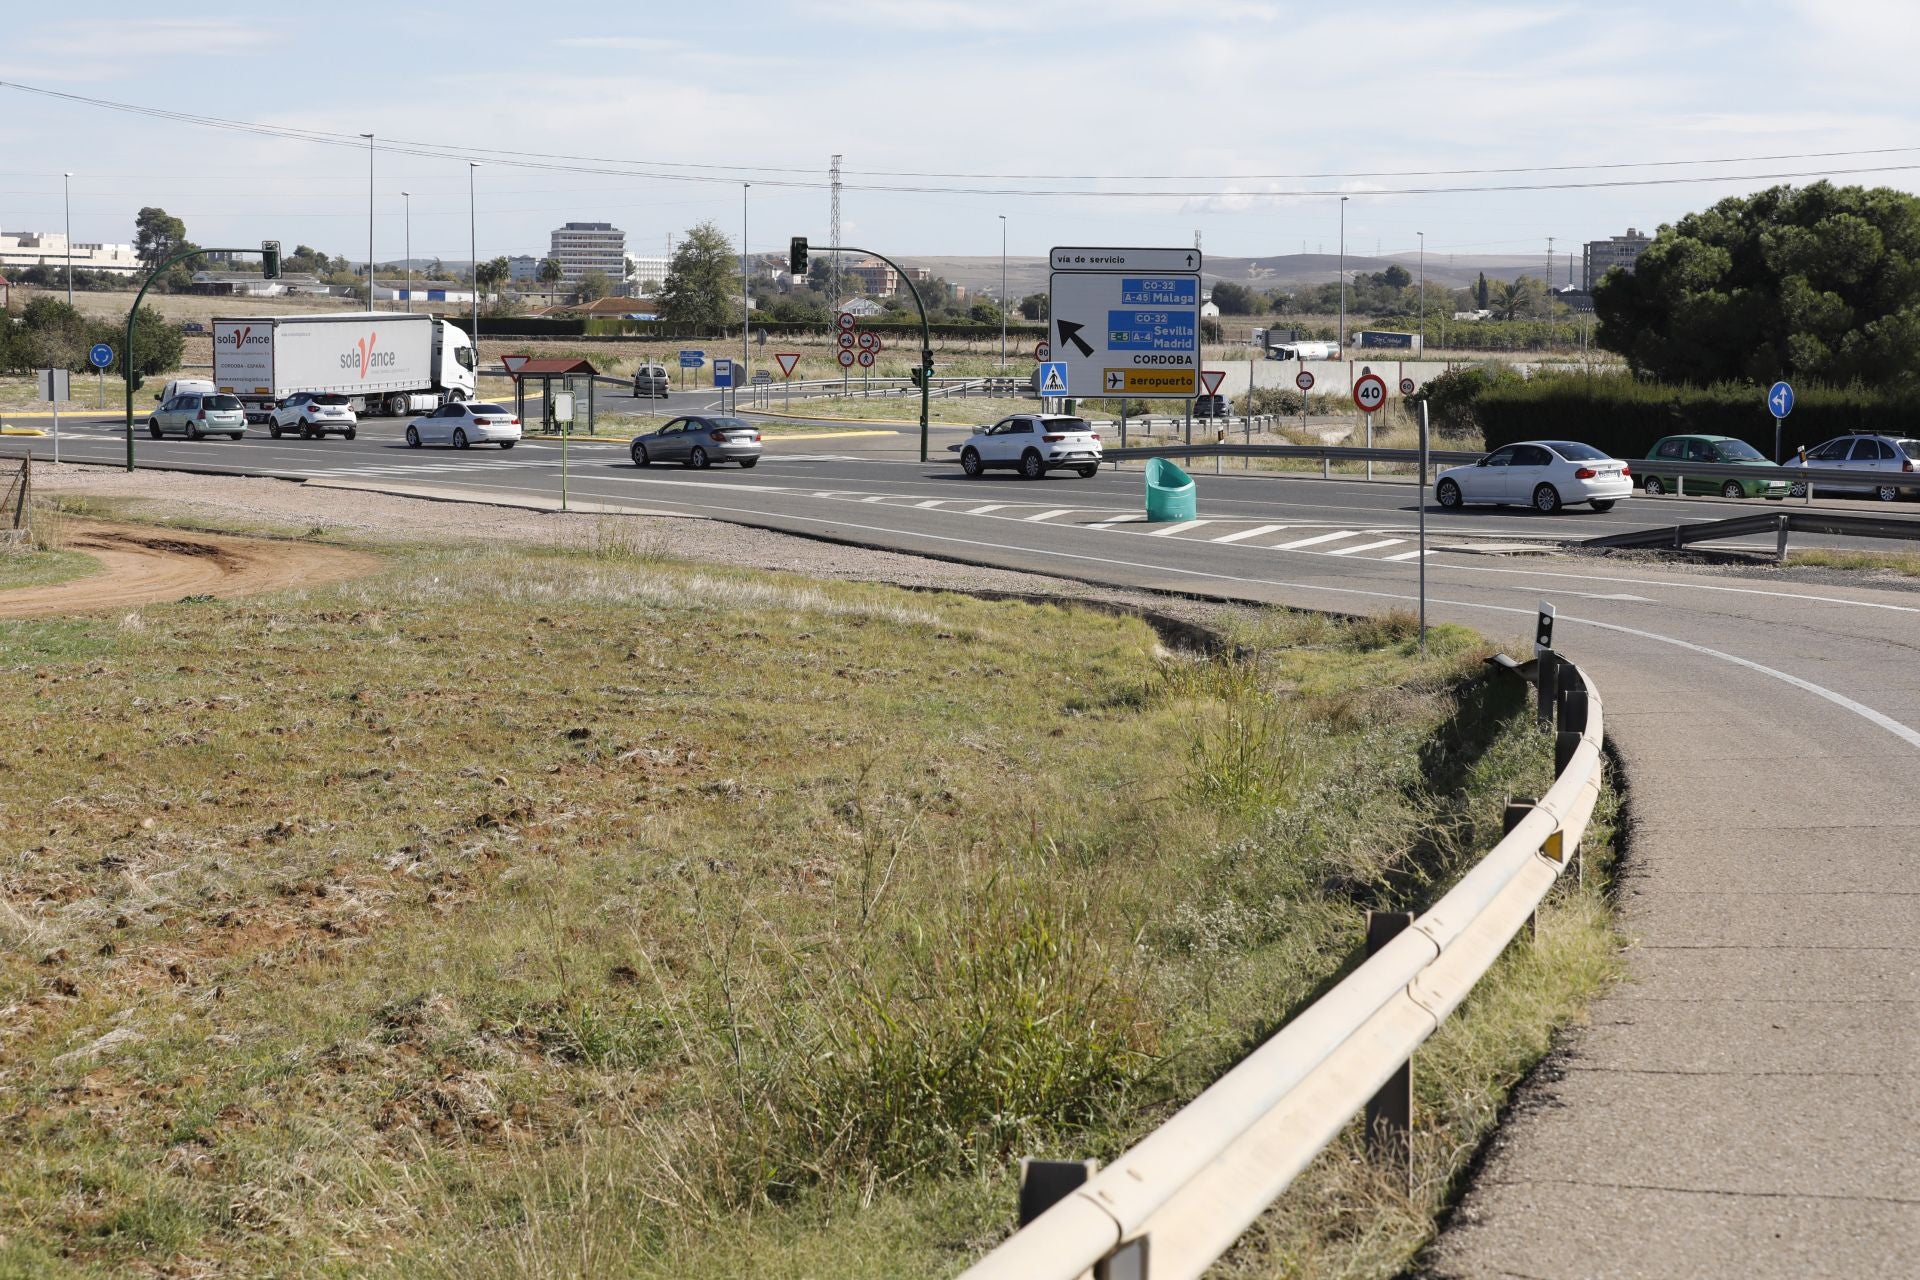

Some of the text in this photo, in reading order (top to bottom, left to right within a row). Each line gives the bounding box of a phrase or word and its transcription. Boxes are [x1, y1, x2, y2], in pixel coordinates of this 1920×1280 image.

[1057, 255, 1126, 264] vía de servicio
[1143, 281, 1174, 290] CO-32
[1124, 293, 1149, 302] A-45
[1136, 314, 1167, 323] CO-32
[1153, 326, 1193, 336] Sevilla
[1110, 332, 1152, 341] E-5 A-4
[1153, 339, 1192, 349] Madrid
[1133, 354, 1193, 365] CORDOBA
[1130, 376, 1193, 387] aeropuerto
[1360, 387, 1380, 399] 40
